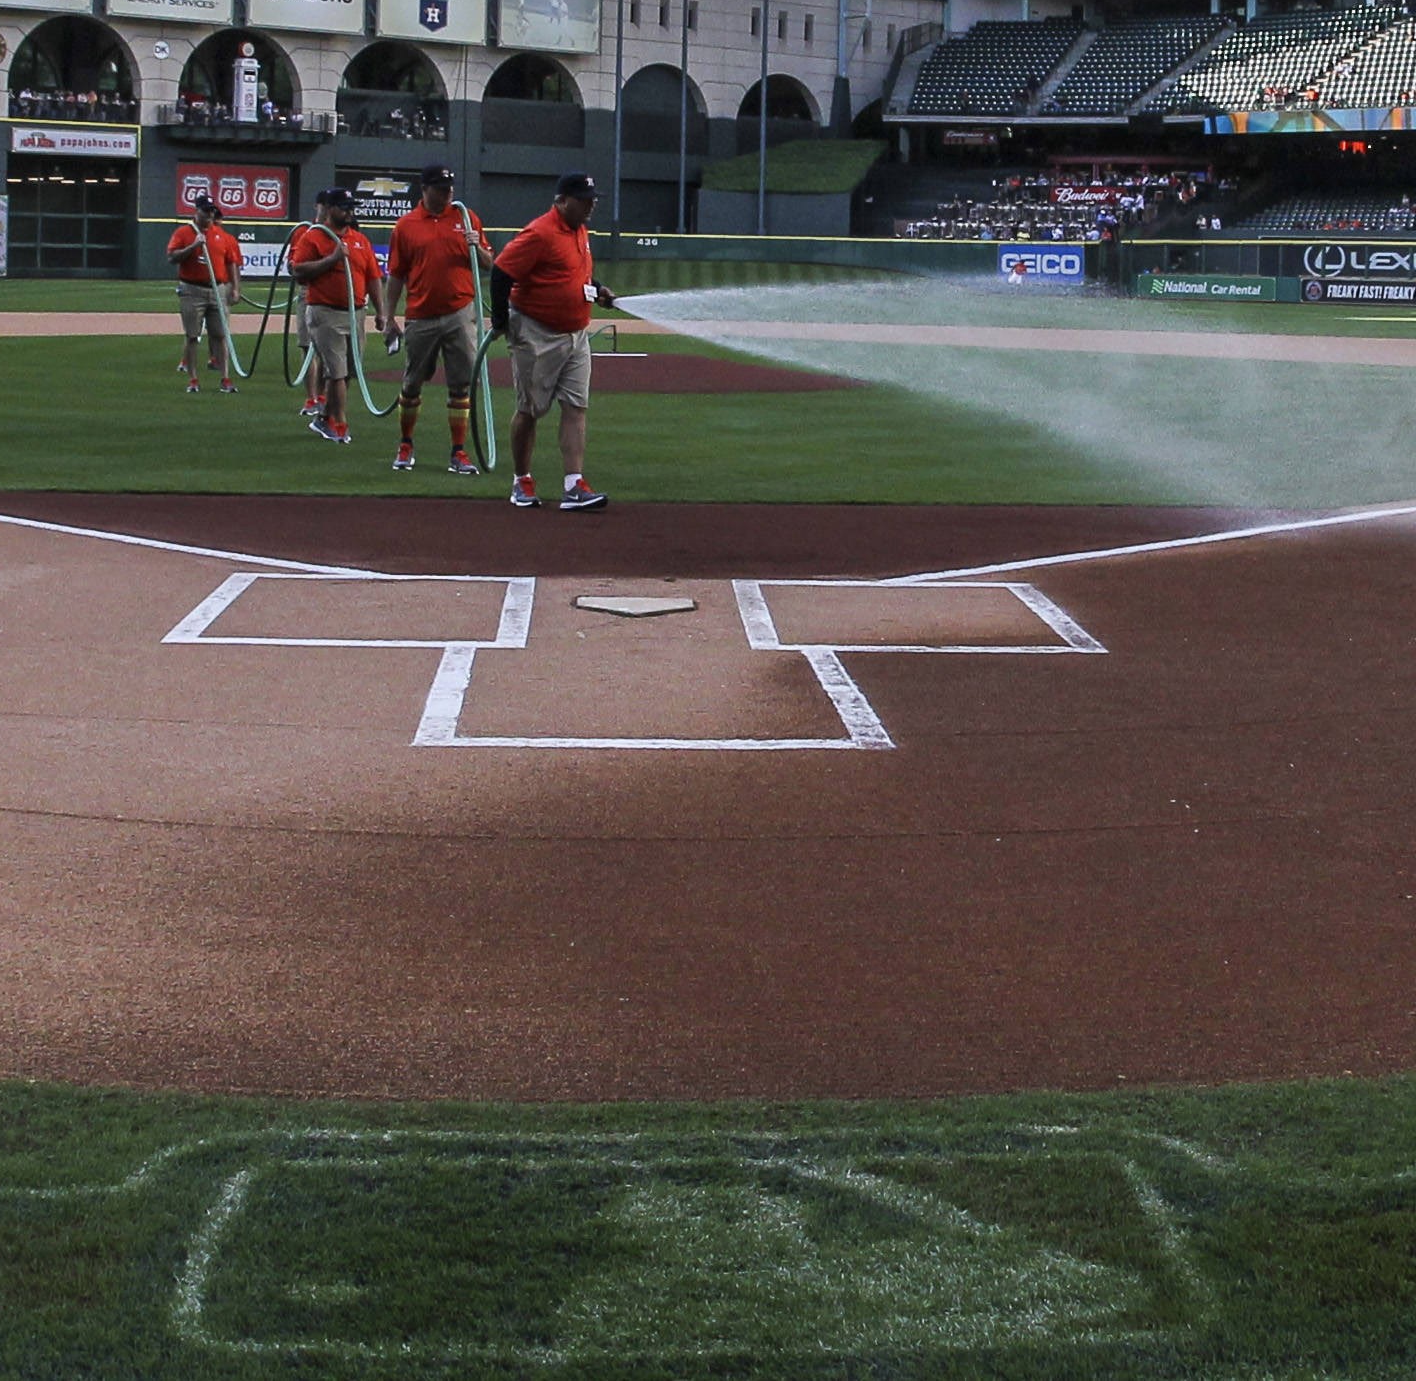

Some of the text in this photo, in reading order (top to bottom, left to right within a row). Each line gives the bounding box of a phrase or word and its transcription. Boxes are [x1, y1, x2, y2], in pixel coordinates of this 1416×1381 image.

[154, 45, 169, 55] DK
[60, 137, 131, 149] papajohns.com
[223, 190, 242, 202] 66
[258, 191, 276, 203] 66
[392, 200, 412, 210] AREA
[354, 209, 378, 217] CHEVY
[237, 232, 255, 242] 404
[637, 237, 658, 246] 436
[1001, 253, 1081, 275] GEICO
[1164, 280, 1261, 296] National Car Rental
[1327, 283, 1412, 301] FREAKY FAST! FREAKY
